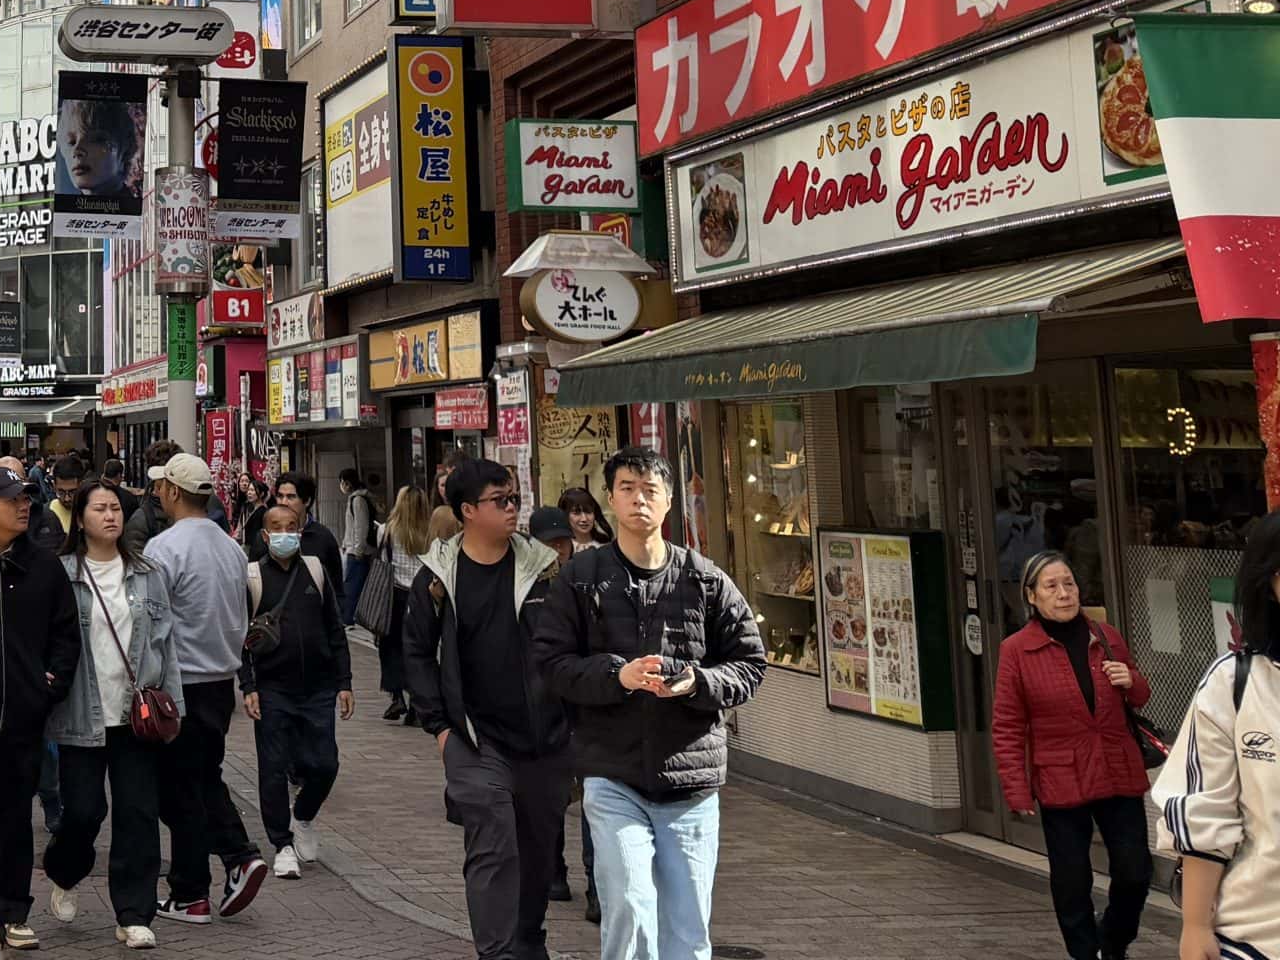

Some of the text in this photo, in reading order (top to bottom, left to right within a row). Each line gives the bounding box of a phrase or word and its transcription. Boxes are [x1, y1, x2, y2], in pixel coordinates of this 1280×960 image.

[73, 18, 224, 41] 渋谷センター街
[815, 81, 972, 159] パスタとピザの店
[414, 103, 452, 184] 松屋
[525, 145, 613, 170] Miami
[762, 147, 888, 226] Miami
[930, 174, 1036, 214] マイアミガーデン
[159, 206, 207, 228] WELCOME
[423, 248, 451, 260] 24h
[427, 263, 447, 275] 1F
[565, 285, 608, 303] てんぐ
[227, 297, 250, 318] B1
[557, 301, 618, 321] 大ホール
